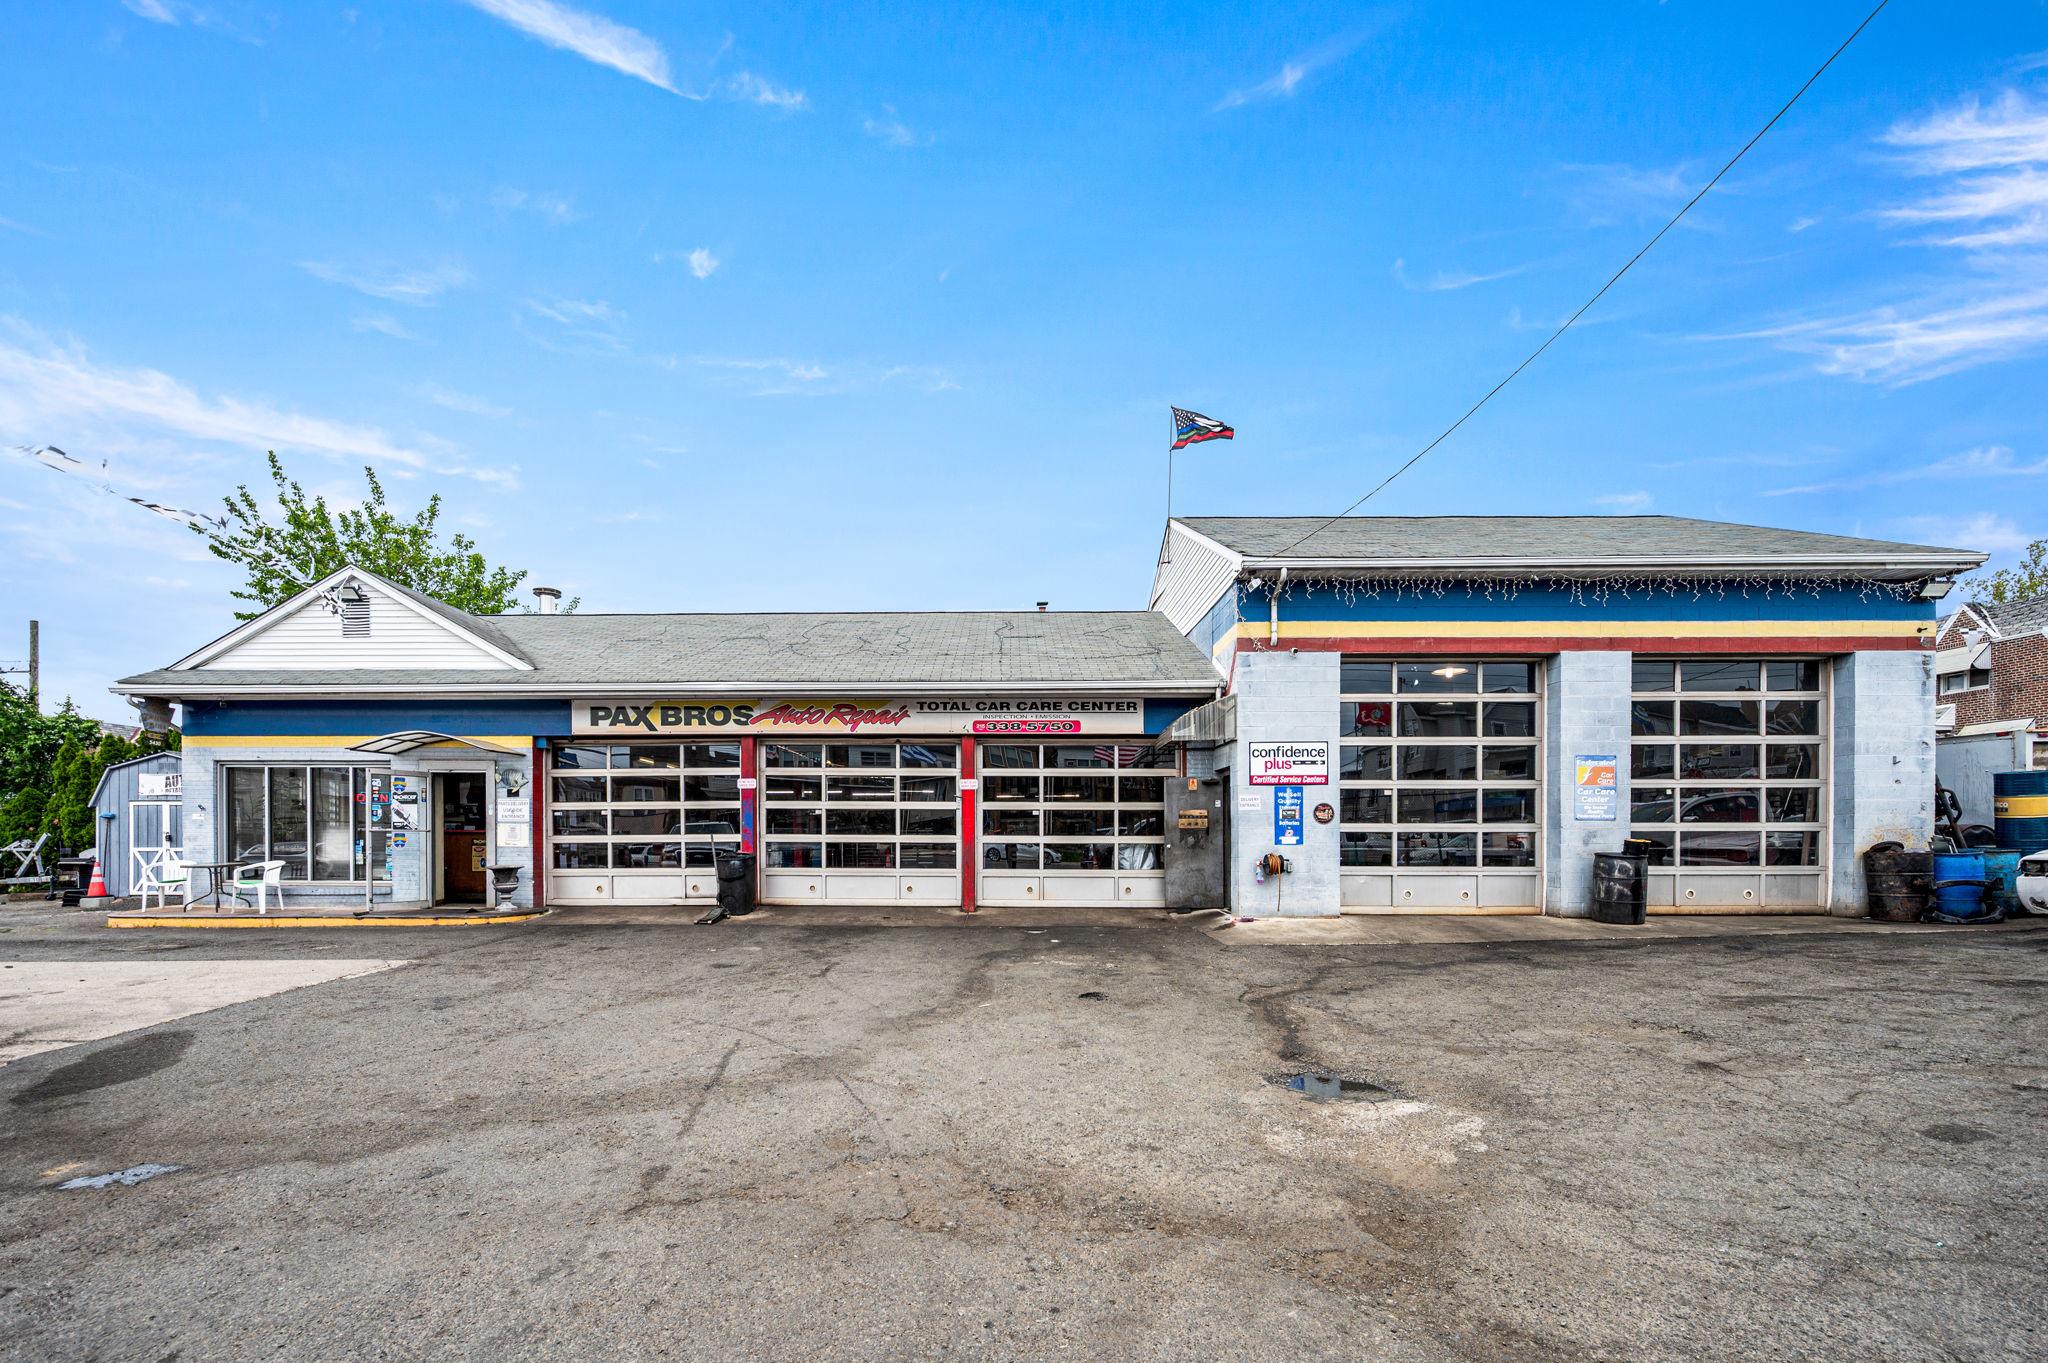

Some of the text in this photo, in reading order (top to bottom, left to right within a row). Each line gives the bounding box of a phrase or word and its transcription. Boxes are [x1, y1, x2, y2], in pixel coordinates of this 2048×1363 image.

[917, 702, 1138, 711] TOTAL CAR CARE CENTER
[590, 705, 753, 731] PAX BROS
[749, 704, 911, 732] Auto Repair
[1252, 746, 1326, 758] confidence
[1264, 758, 1292, 772] plus
